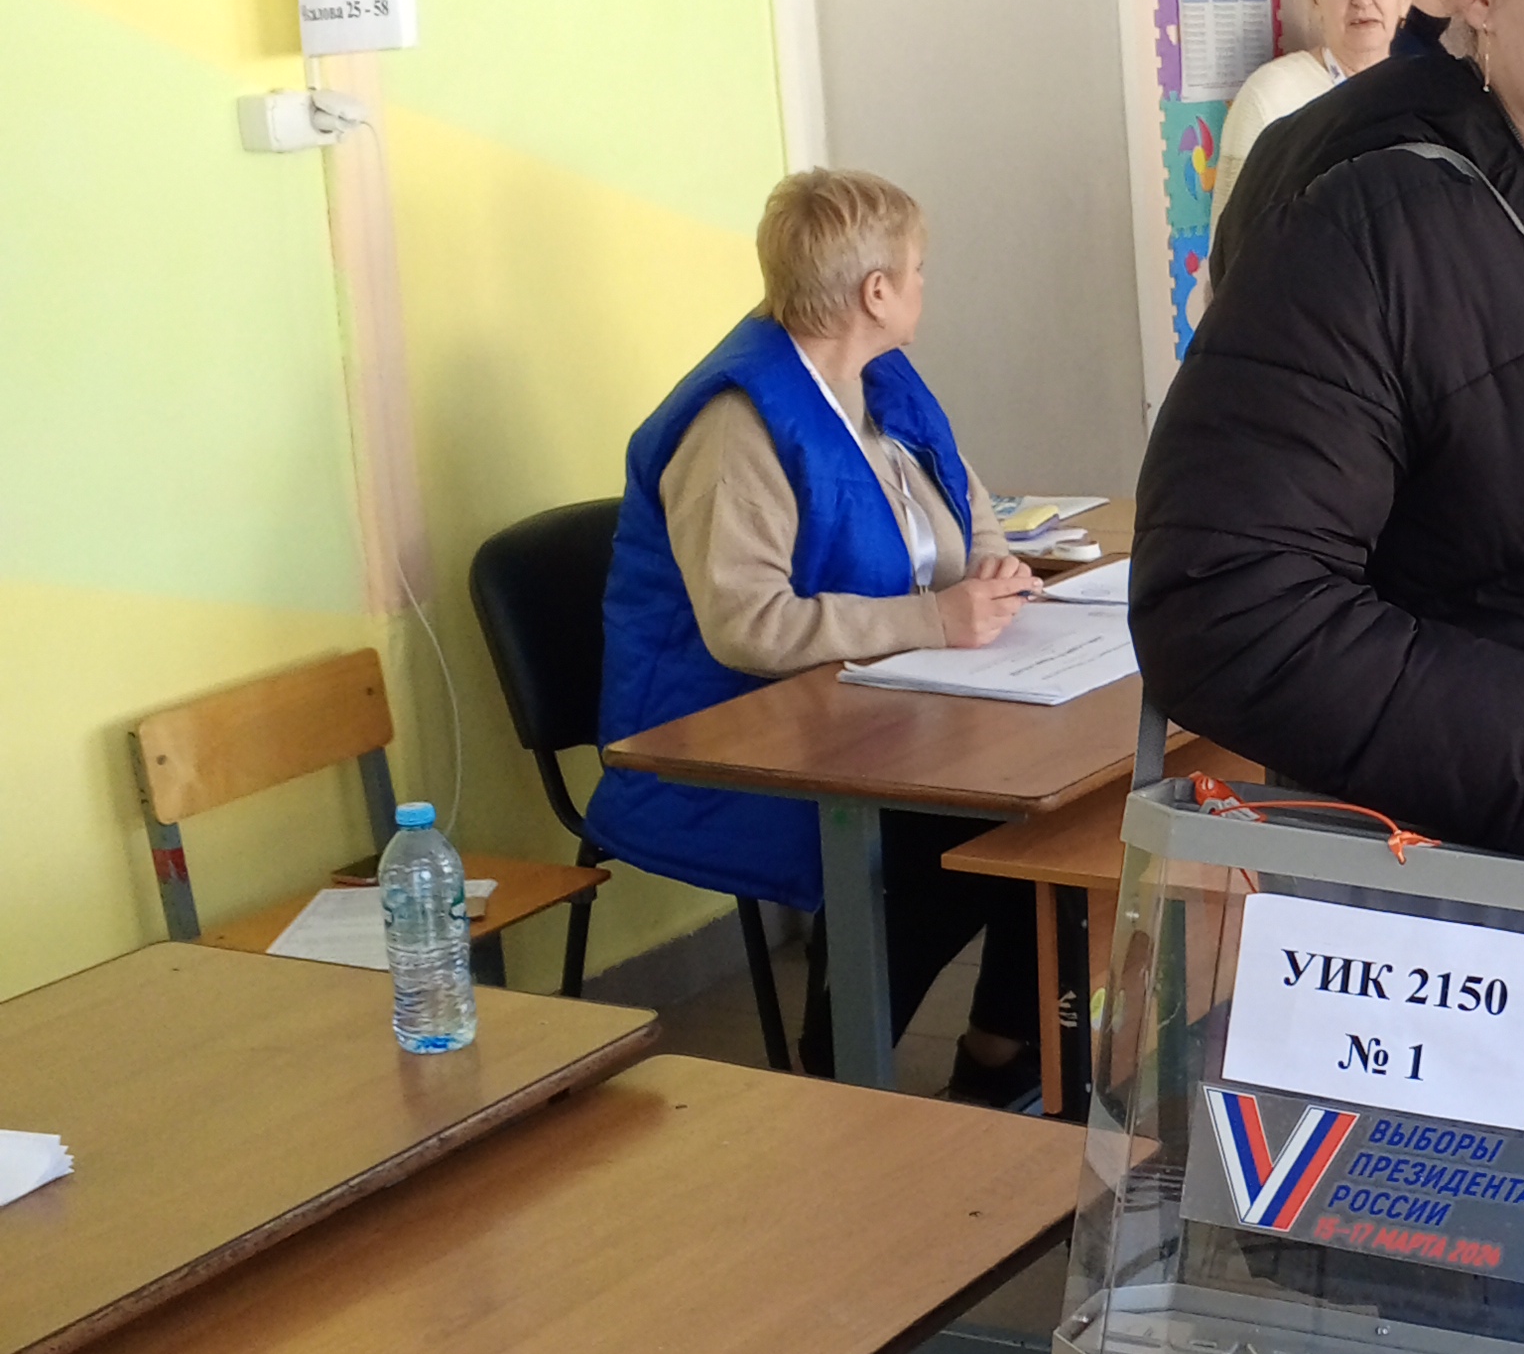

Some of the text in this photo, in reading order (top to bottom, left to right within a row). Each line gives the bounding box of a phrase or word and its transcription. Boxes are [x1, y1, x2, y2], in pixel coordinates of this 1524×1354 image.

[346, 1, 361, 18] 25
[374, 0, 390, 16] 58
[1281, 948, 1509, 1016] УИК 2150
[1338, 1033, 1425, 1082] № 1
[1368, 1119, 1504, 1163] ВЫБОРЫ
[1327, 1185, 1452, 1226] РОССИИ
[1372, 1226, 1447, 1259] МАРТА
[1448, 1239, 1502, 1267] 2024
